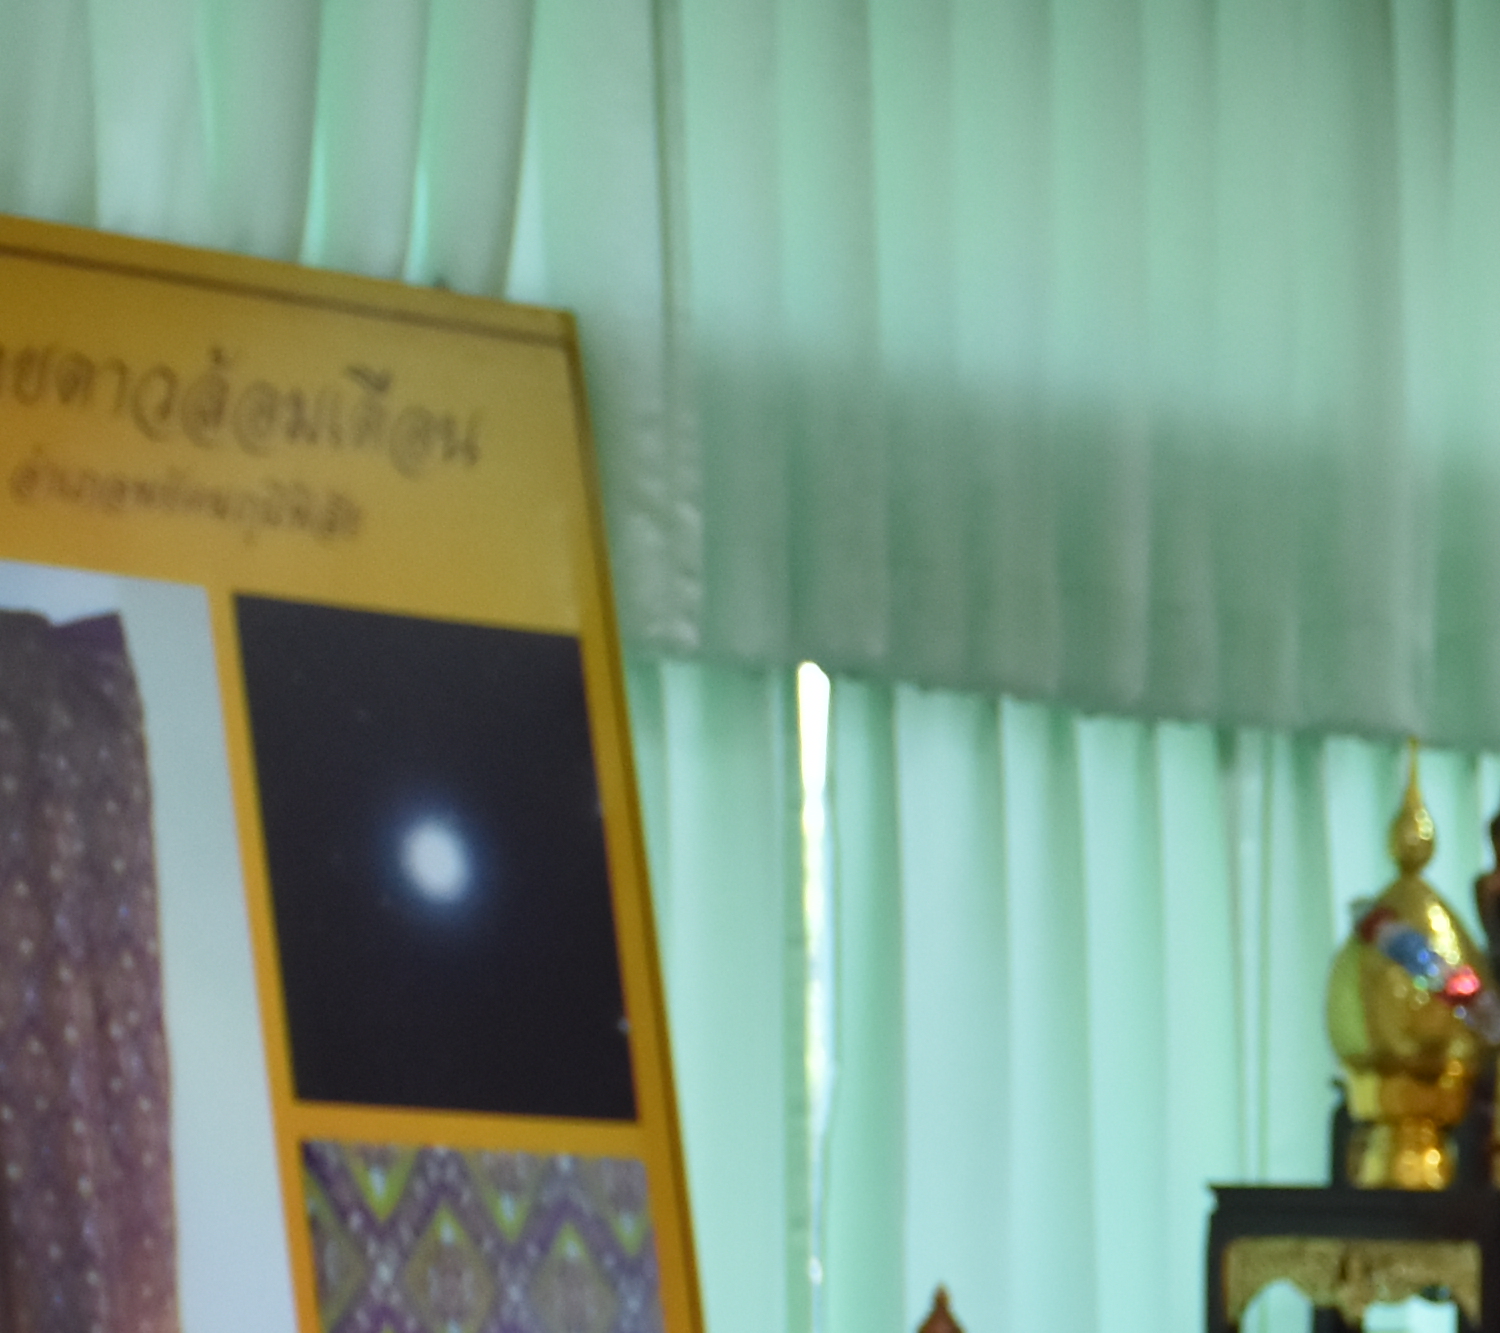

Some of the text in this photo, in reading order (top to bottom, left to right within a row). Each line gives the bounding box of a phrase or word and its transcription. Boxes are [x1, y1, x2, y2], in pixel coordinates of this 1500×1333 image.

[0, 343, 487, 480] ยดาวล้อมเดือน
